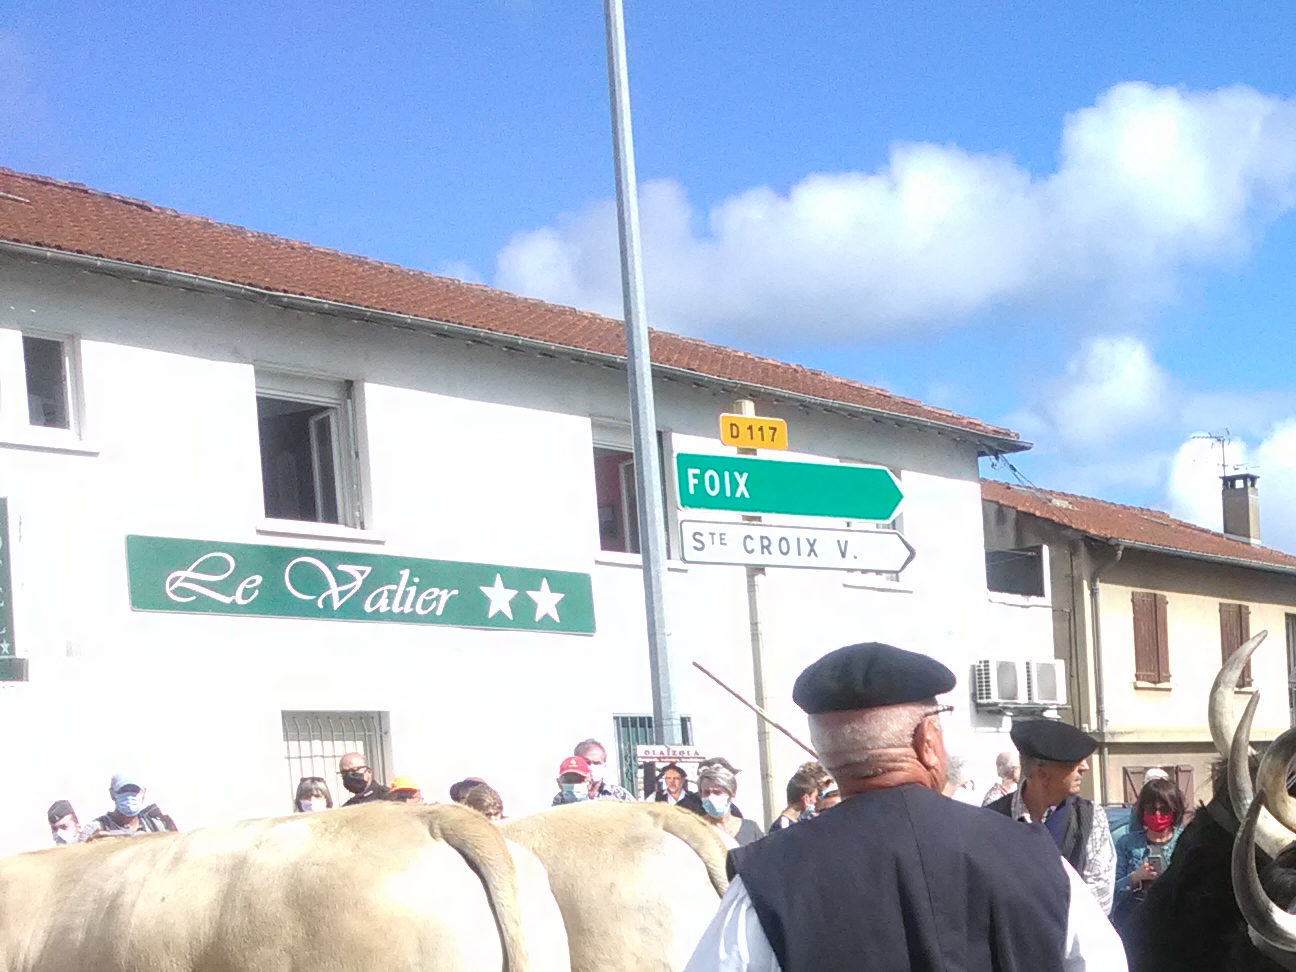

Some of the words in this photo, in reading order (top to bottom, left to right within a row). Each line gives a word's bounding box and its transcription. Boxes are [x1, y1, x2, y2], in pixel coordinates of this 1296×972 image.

[729, 422, 740, 439] D
[746, 425, 778, 442] 117
[687, 467, 750, 499] FOIX
[742, 534, 819, 559] CROIX
[836, 539, 859, 561] V.
[165, 552, 263, 605] Le
[284, 556, 460, 616] Valier
